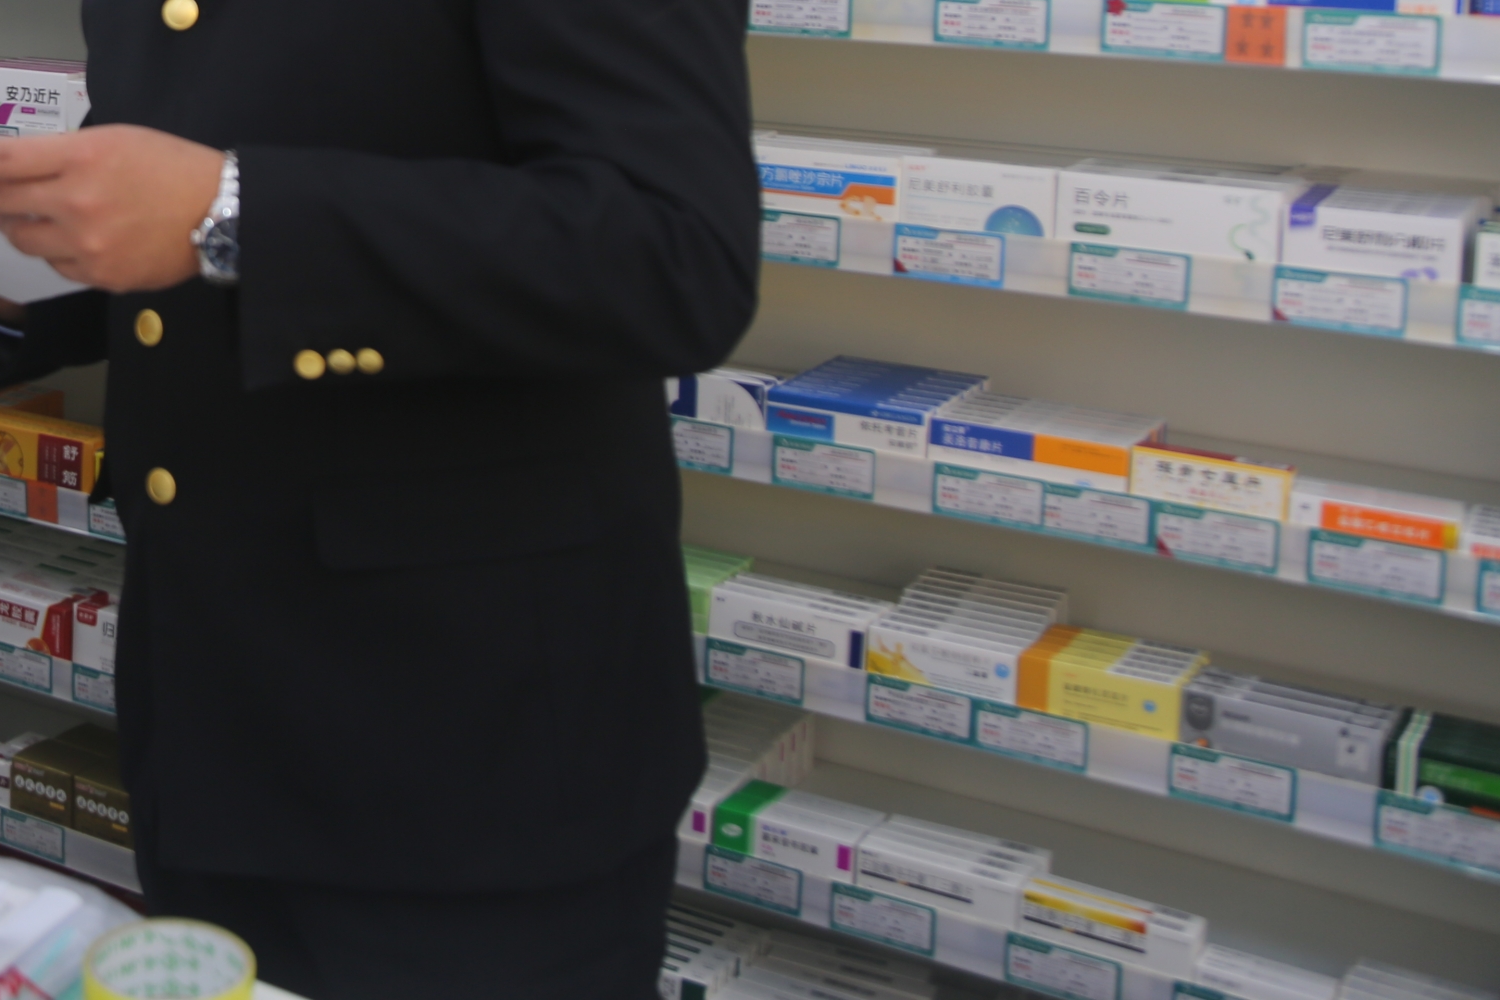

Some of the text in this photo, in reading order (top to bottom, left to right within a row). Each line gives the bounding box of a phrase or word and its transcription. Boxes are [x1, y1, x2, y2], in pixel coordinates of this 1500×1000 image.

[6, 86, 61, 105] 安乃近片
[907, 175, 994, 199] 尼美舒利胶囊
